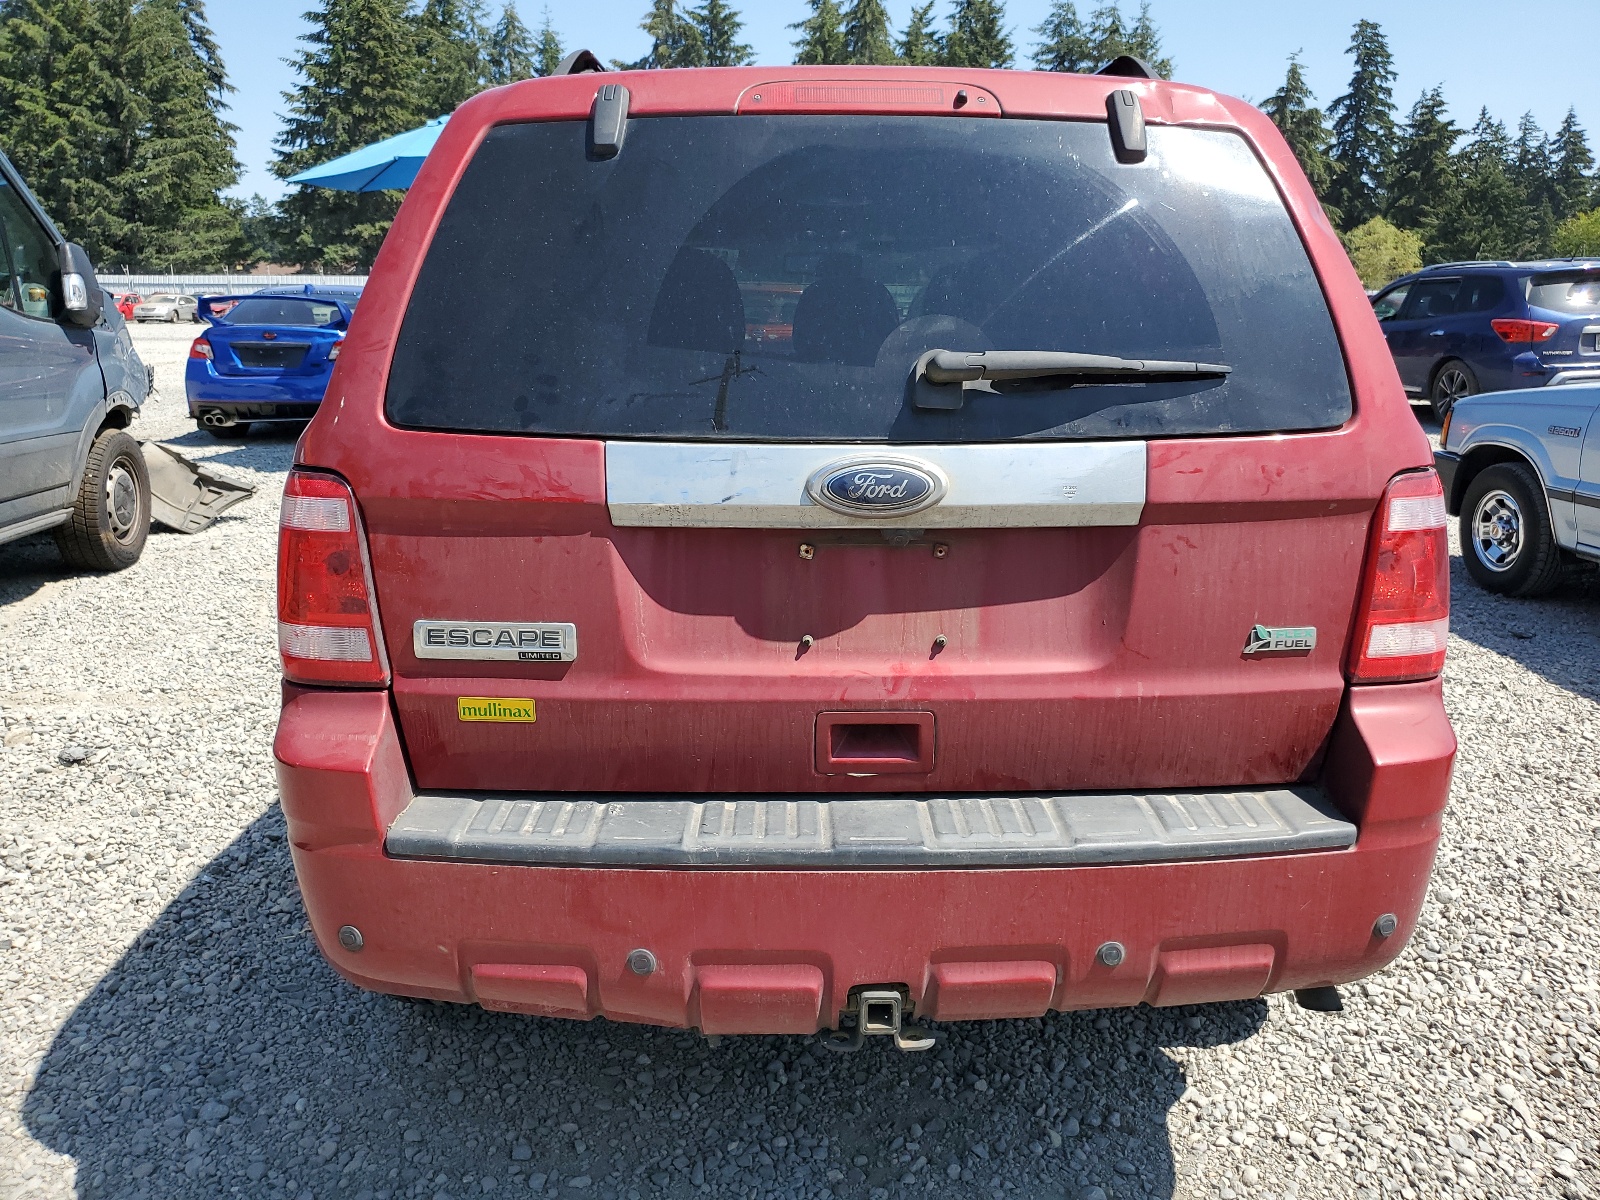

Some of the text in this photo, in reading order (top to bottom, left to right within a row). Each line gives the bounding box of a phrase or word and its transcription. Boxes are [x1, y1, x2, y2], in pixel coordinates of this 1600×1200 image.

[848, 472, 908, 498] Ford
[427, 628, 560, 647] ESCAPE
[1276, 629, 1313, 638] FLEX
[1275, 640, 1312, 648] FUEL
[461, 702, 532, 718] mullinax
